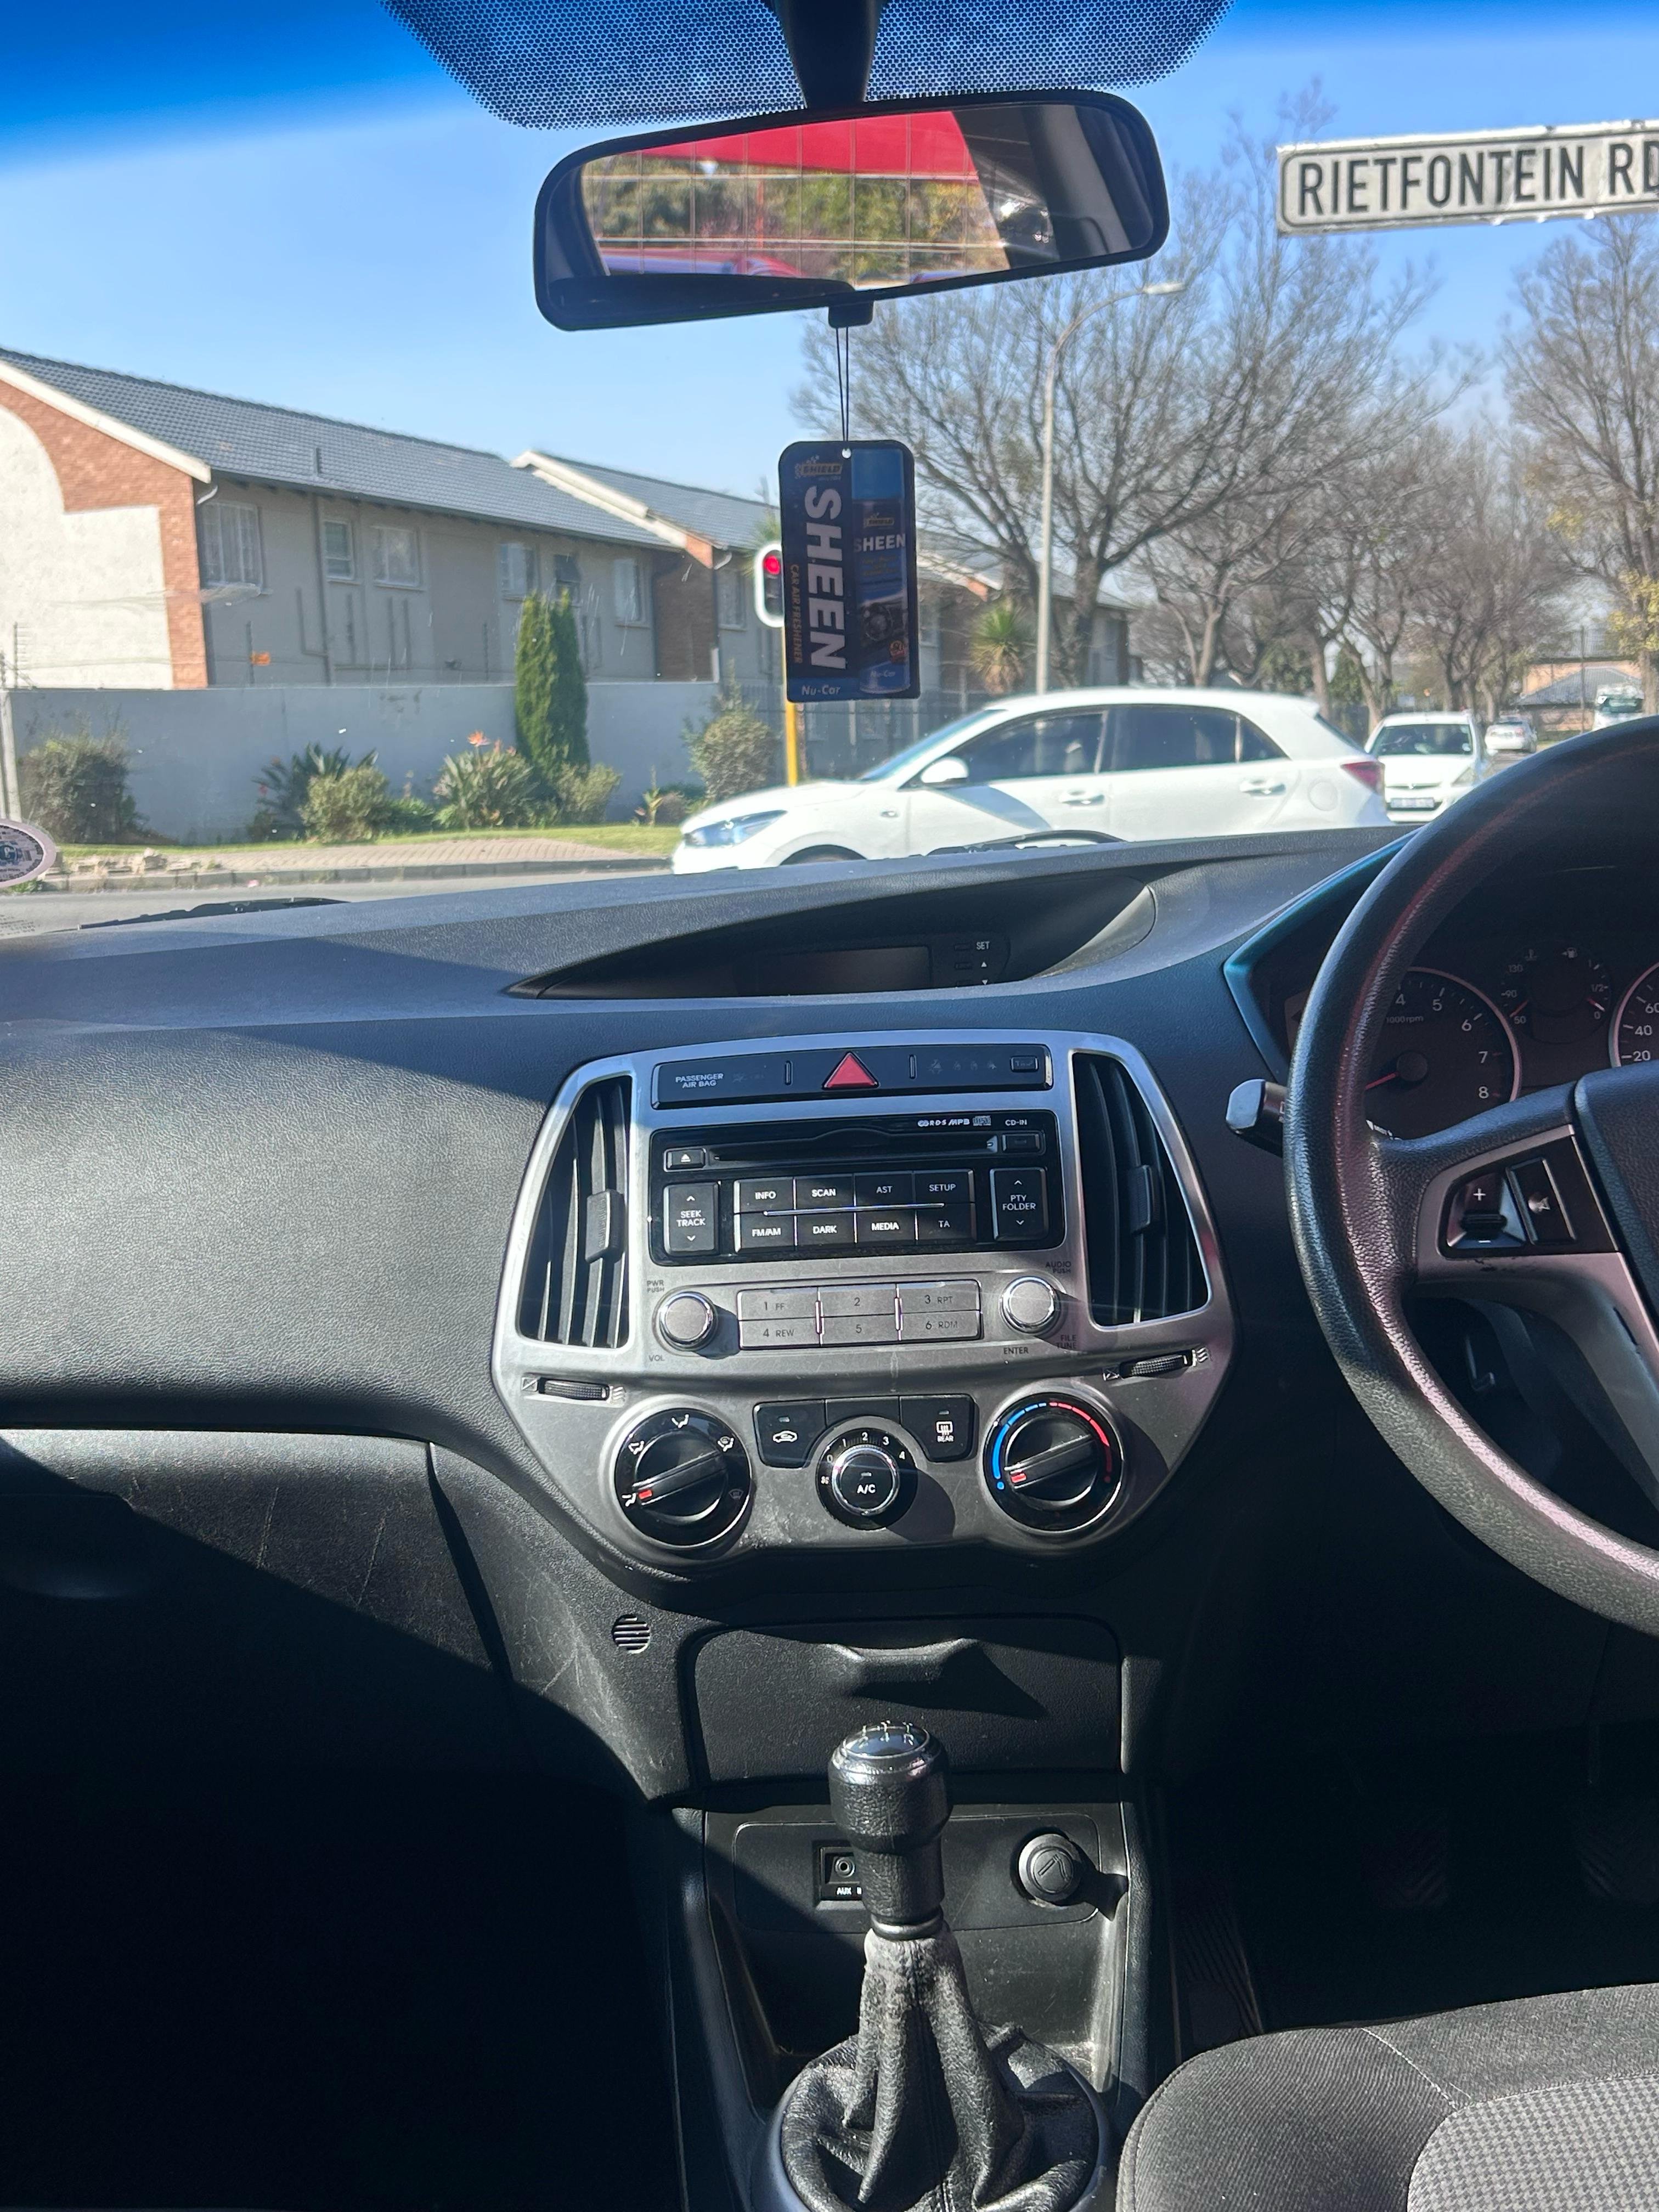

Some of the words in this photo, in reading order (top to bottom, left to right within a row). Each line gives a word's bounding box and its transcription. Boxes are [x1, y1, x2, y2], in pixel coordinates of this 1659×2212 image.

[1298, 145, 1584, 216] RIETFONTEIN
[1609, 141, 1659, 196] RD
[853, 533, 906, 552] SHEEN
[789, 564, 800, 585] CAR
[804, 485, 847, 670] SHEEN
[791, 586, 801, 605] AIR
[792, 605, 803, 664] FRESHENER
[801, 684, 841, 696] Nu-Car
[976, 941, 990, 950] SET
[1508, 964, 1523, 973] 130
[1591, 984, 1604, 992] 1/2
[1505, 990, 1517, 998] 90
[1395, 994, 1406, 1006] 4
[1432, 998, 1442, 1012] 5
[1645, 1002, 1659, 1014] 60
[1406, 1015, 1424, 1024] rpm
[1514, 1015, 1527, 1024] 50
[1594, 1011, 1601, 1019] 0
[1461, 1019, 1472, 1032] 6
[1634, 1024, 1653, 1036] 40
[1479, 1051, 1488, 1064] 7
[1633, 1049, 1651, 1062] 20
[675, 1073, 724, 1082] PASSENGER
[1479, 1086, 1489, 1099] 8
[929, 1183, 956, 1192] SETUP
[755, 1190, 777, 1200] INFO
[811, 1188, 836, 1198] SCAN
[1010, 1194, 1027, 1203] PTY
[1002, 1202, 1036, 1211] FOLDER
[680, 1210, 702, 1218] SEEK
[676, 1217, 706, 1227] TRACK
[871, 1222, 900, 1231] MEDIA
[752, 1227, 781, 1237] FM/AM
[812, 1224, 837, 1234] DARK
[854, 1298, 861, 1307] 2
[924, 1295, 931, 1305] 3
[937, 1296, 953, 1304] RPT
[764, 1302, 768, 1310] 1
[855, 1324, 862, 1334] 5
[926, 1321, 932, 1330] 6
[938, 1320, 958, 1329] RDM
[763, 1329, 769, 1338] 4
[775, 1329, 794, 1338] REW
[861, 1432, 868, 1441] 2
[882, 1436, 889, 1446] 3
[842, 1438, 847, 1447] 1
[899, 1451, 905, 1460] 4
[856, 1484, 876, 1494] A/C
[837, 1887, 852, 1895] AUX
